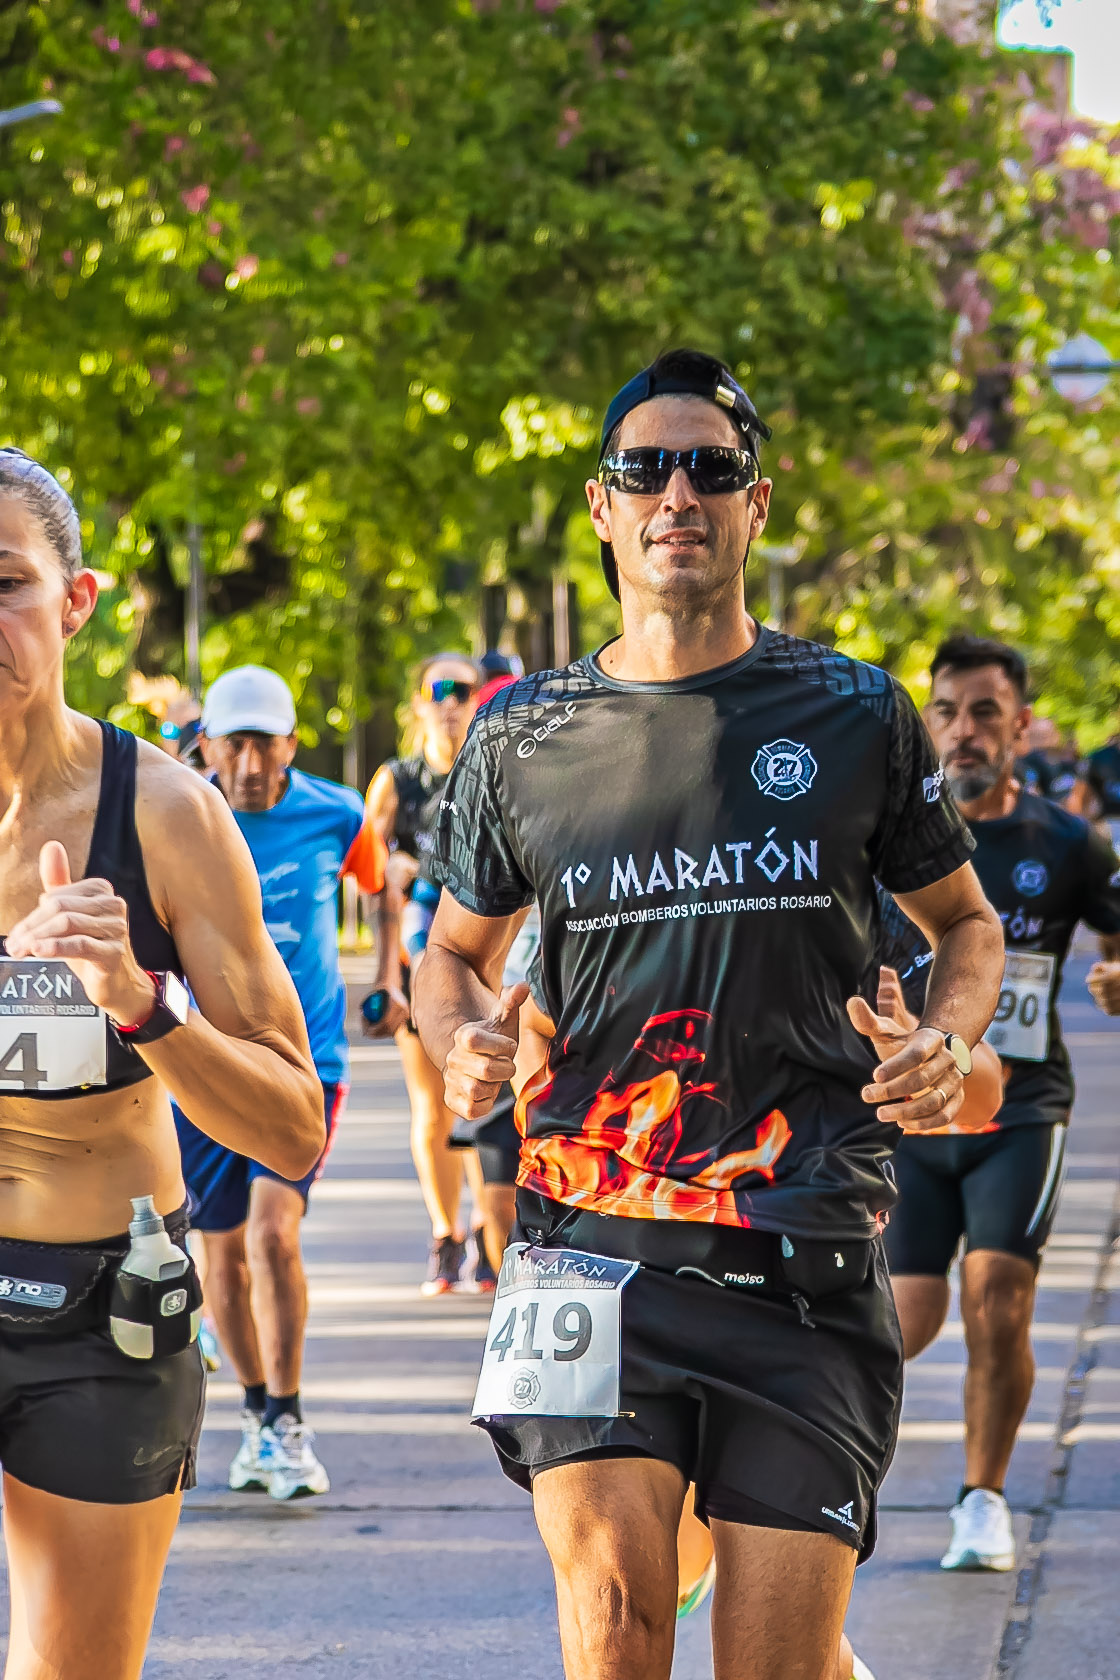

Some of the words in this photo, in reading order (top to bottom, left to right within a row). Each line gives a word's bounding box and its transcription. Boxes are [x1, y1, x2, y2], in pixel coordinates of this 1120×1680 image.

[610, 826, 819, 901] MARATÓN
[621, 905, 689, 926] BOMBEROS
[690, 896, 777, 916] VOLUNTARIOS
[780, 895, 832, 910] ROSARIO
[514, 1257, 608, 1278] MARATÓN
[489, 1301, 593, 1363] 419
